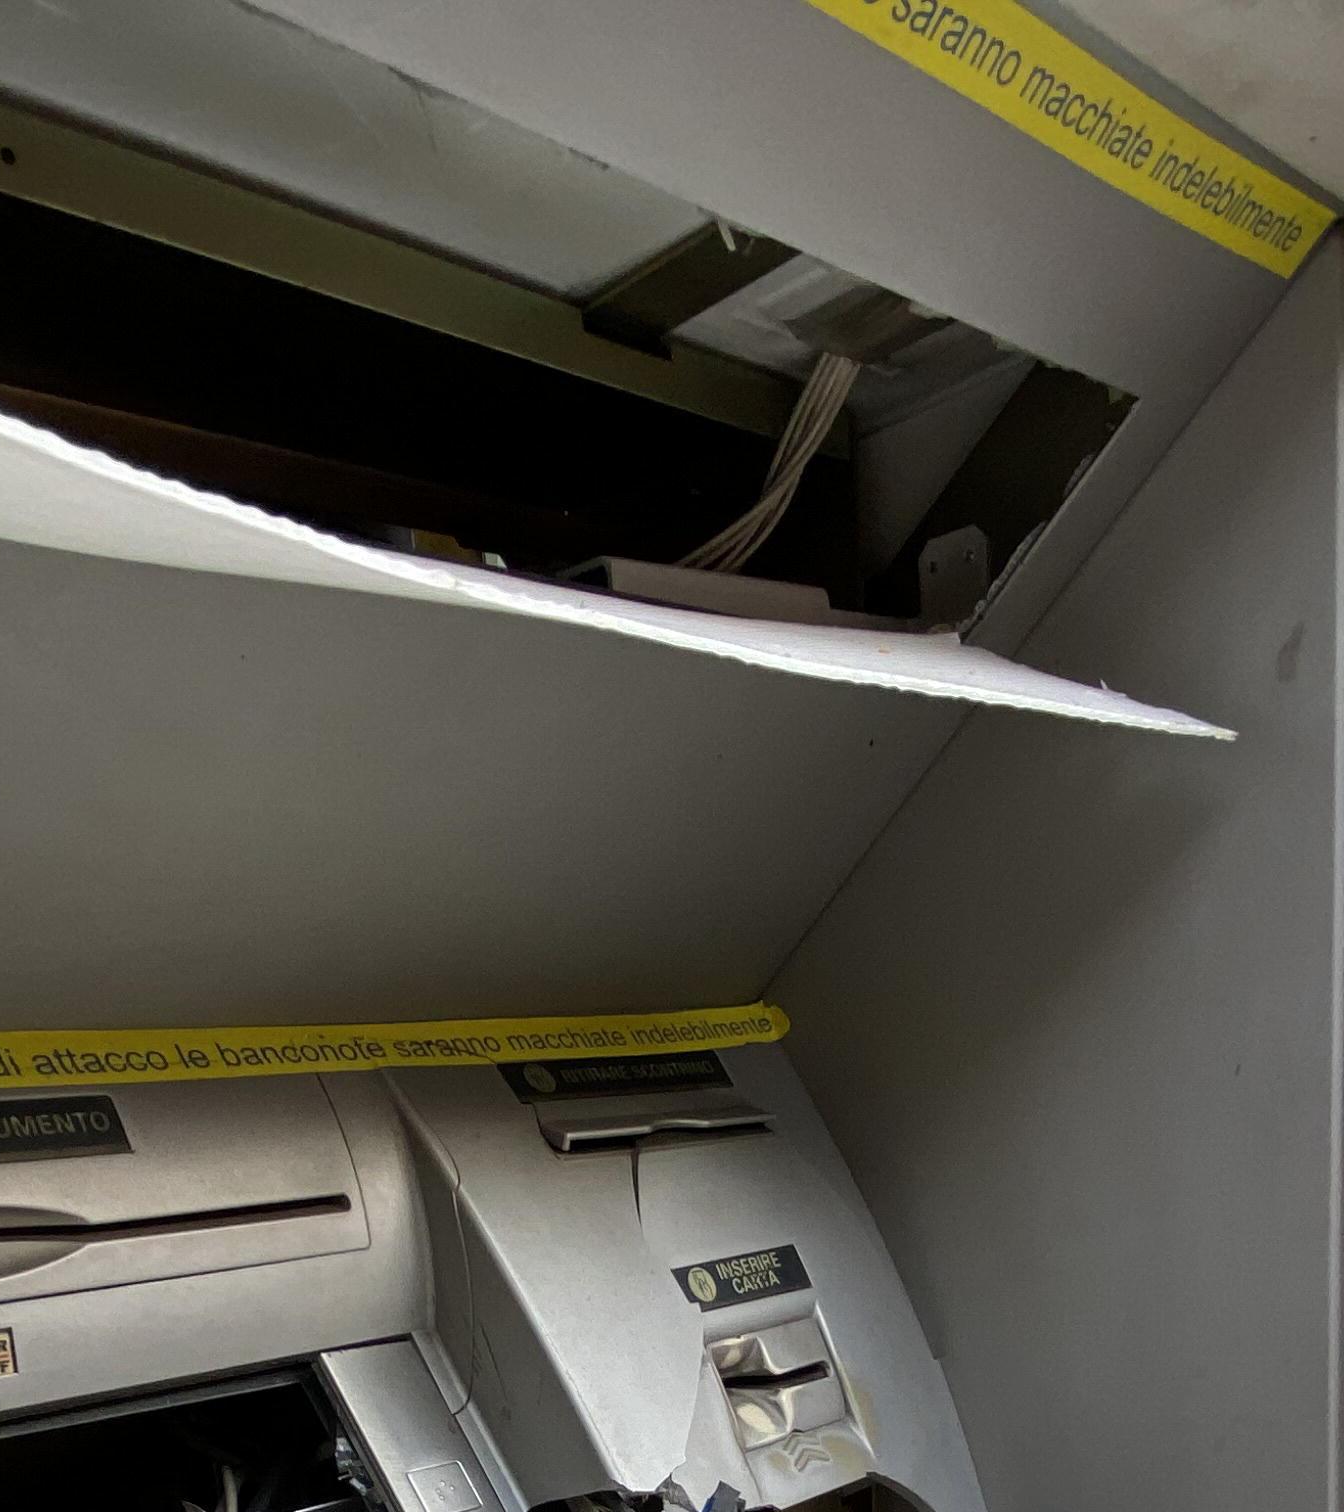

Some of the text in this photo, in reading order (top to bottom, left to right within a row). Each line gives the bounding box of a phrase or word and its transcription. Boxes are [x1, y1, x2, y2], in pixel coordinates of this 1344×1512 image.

[890, 0, 1304, 254] saranno macchiate indelebilmente
[31, 1043, 170, 1076] attacco
[173, 1041, 211, 1069] le
[215, 1038, 386, 1067] banconote
[392, 1036, 501, 1058] saranno
[506, 1025, 626, 1052] macchiate
[629, 1015, 773, 1047] indelebilmente
[715, 1252, 782, 1281] INSERIRE
[732, 1270, 781, 1294] CARTA
